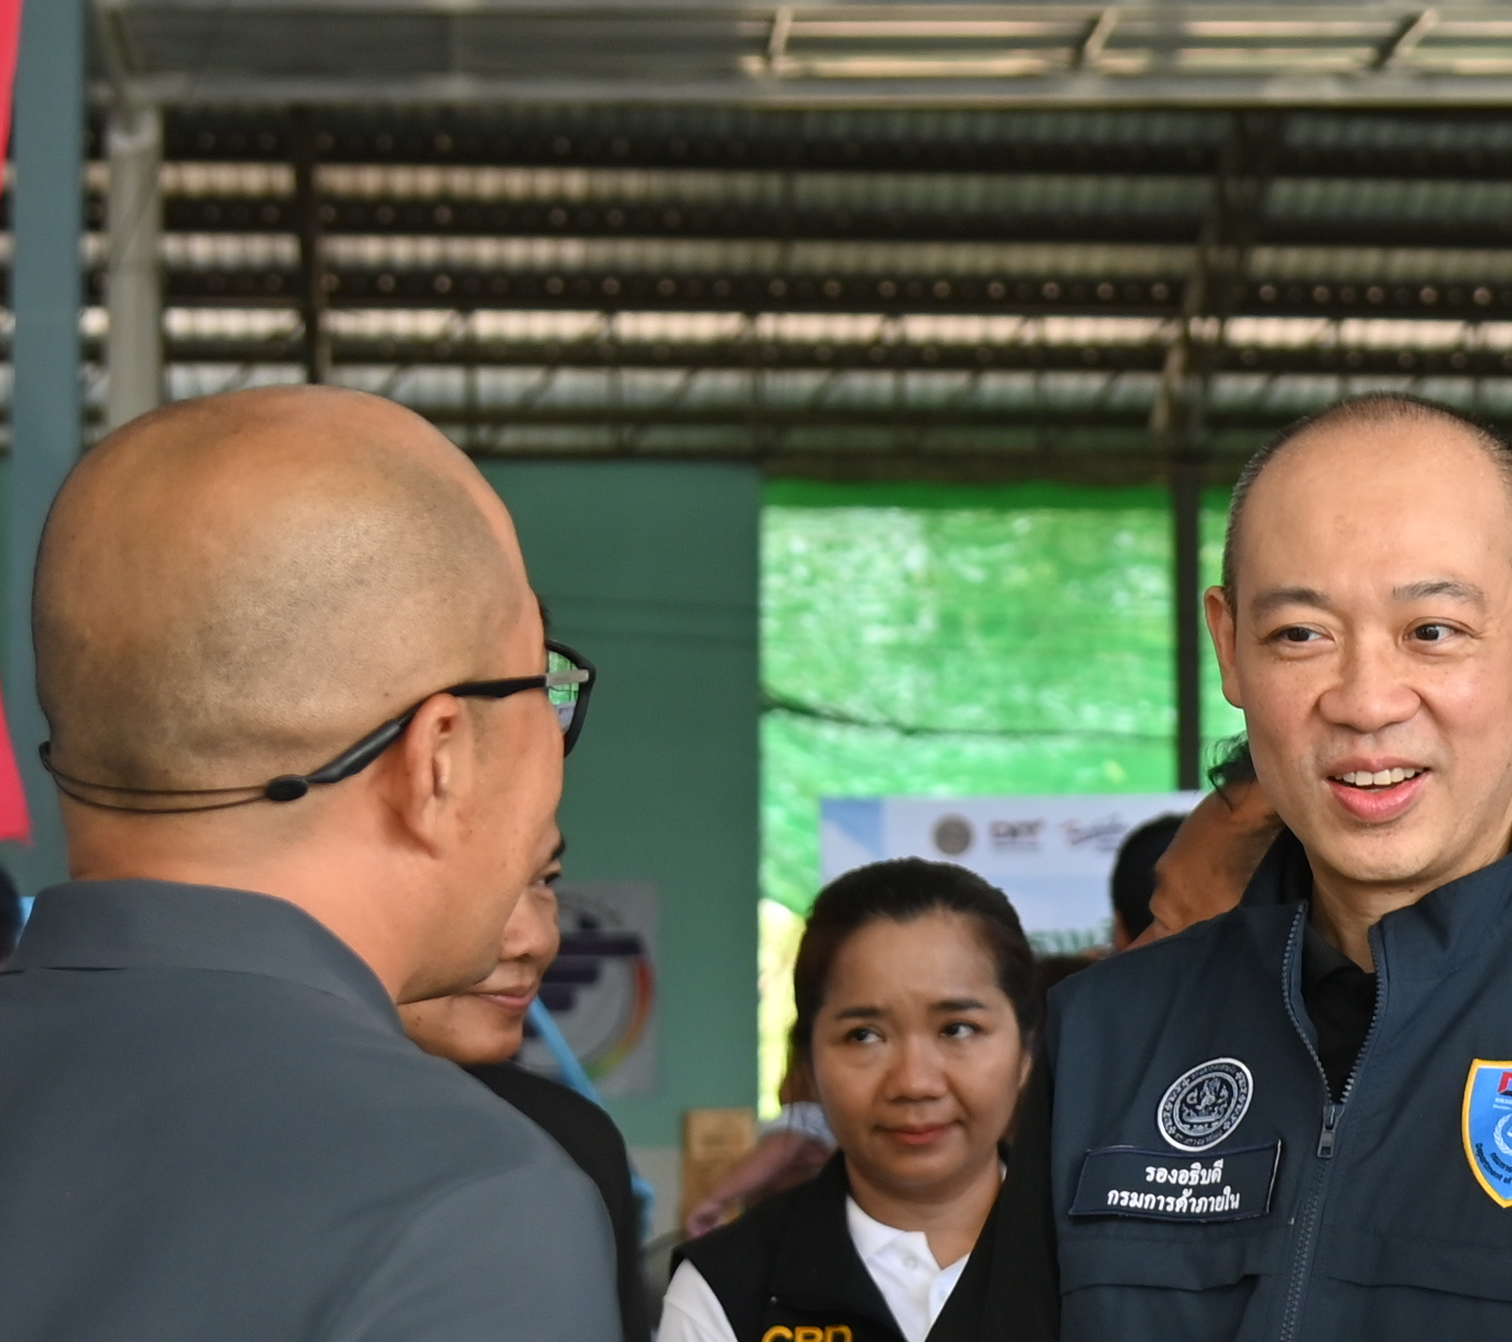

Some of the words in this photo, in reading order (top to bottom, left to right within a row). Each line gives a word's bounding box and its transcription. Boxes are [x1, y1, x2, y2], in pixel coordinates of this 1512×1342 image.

[1144, 1157, 1225, 1186] รองอธิบดี
[1106, 1185, 1241, 1214] กรมการค้าภายใน
